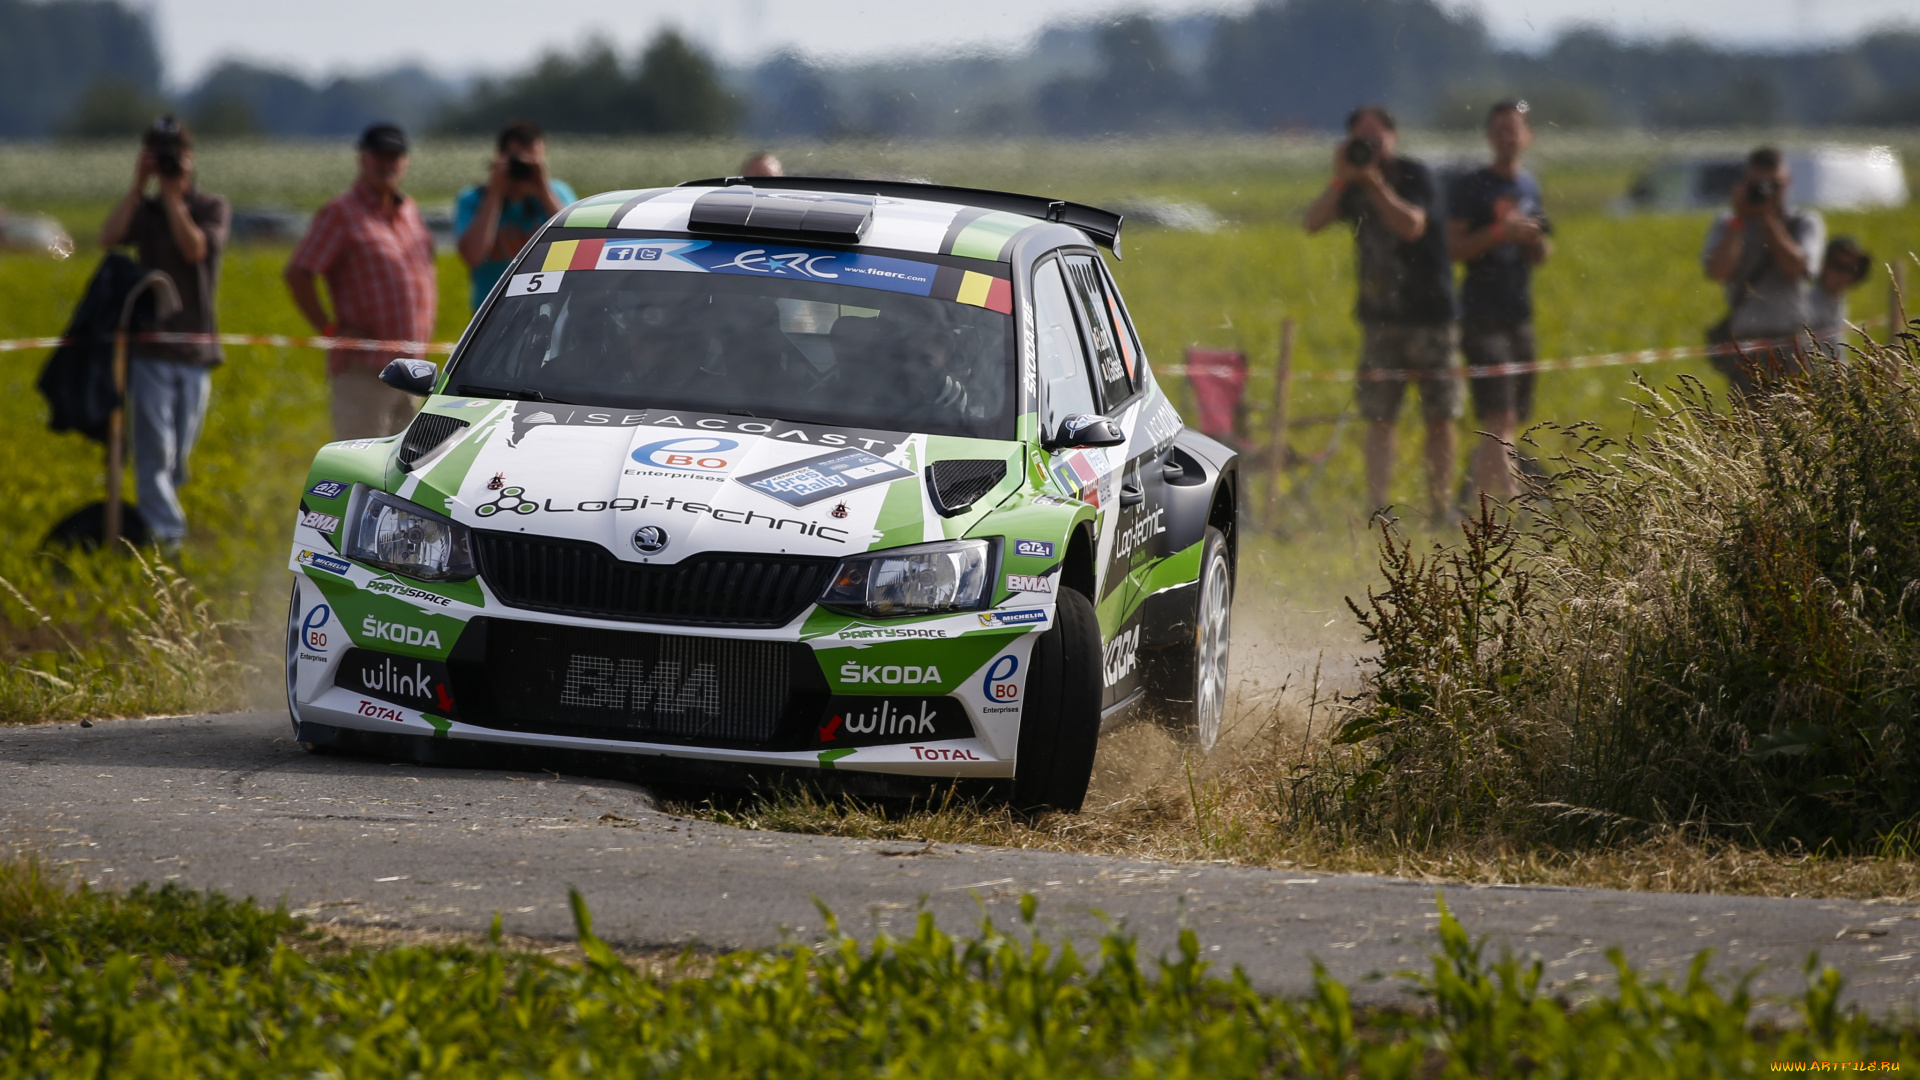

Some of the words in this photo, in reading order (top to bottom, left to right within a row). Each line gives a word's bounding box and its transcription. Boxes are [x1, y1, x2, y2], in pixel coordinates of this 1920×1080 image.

[710, 249, 839, 279] ERC
[844, 266, 927, 283] www.fiaerc.com
[526, 273, 545, 293] 5
[1023, 297, 1037, 399] ŠKODA.BE
[583, 412, 886, 450] SEACOAST
[623, 468, 726, 483] Enterprises
[755, 470, 820, 492] Ypres
[791, 474, 845, 495] Rally
[302, 511, 341, 534] BMA
[543, 496, 850, 544] Logi-technic
[314, 557, 349, 572] MICHELIN
[365, 580, 452, 607] PARTYSPACE
[1007, 574, 1051, 593] BMA
[1002, 612, 1044, 621] MICHELIN
[361, 613, 442, 650] ŠKODA
[838, 629, 948, 640] PARTYSPACE
[300, 652, 328, 663] Enterprises
[1101, 624, 1140, 688] KODA
[362, 658, 433, 699] wlink
[840, 660, 943, 684] ŠKODA
[560, 653, 721, 717] BMA
[358, 699, 405, 723] TOTAL
[845, 699, 937, 736] wlink
[982, 706, 1019, 715] Enterprises
[909, 746, 980, 761] TOTAL
